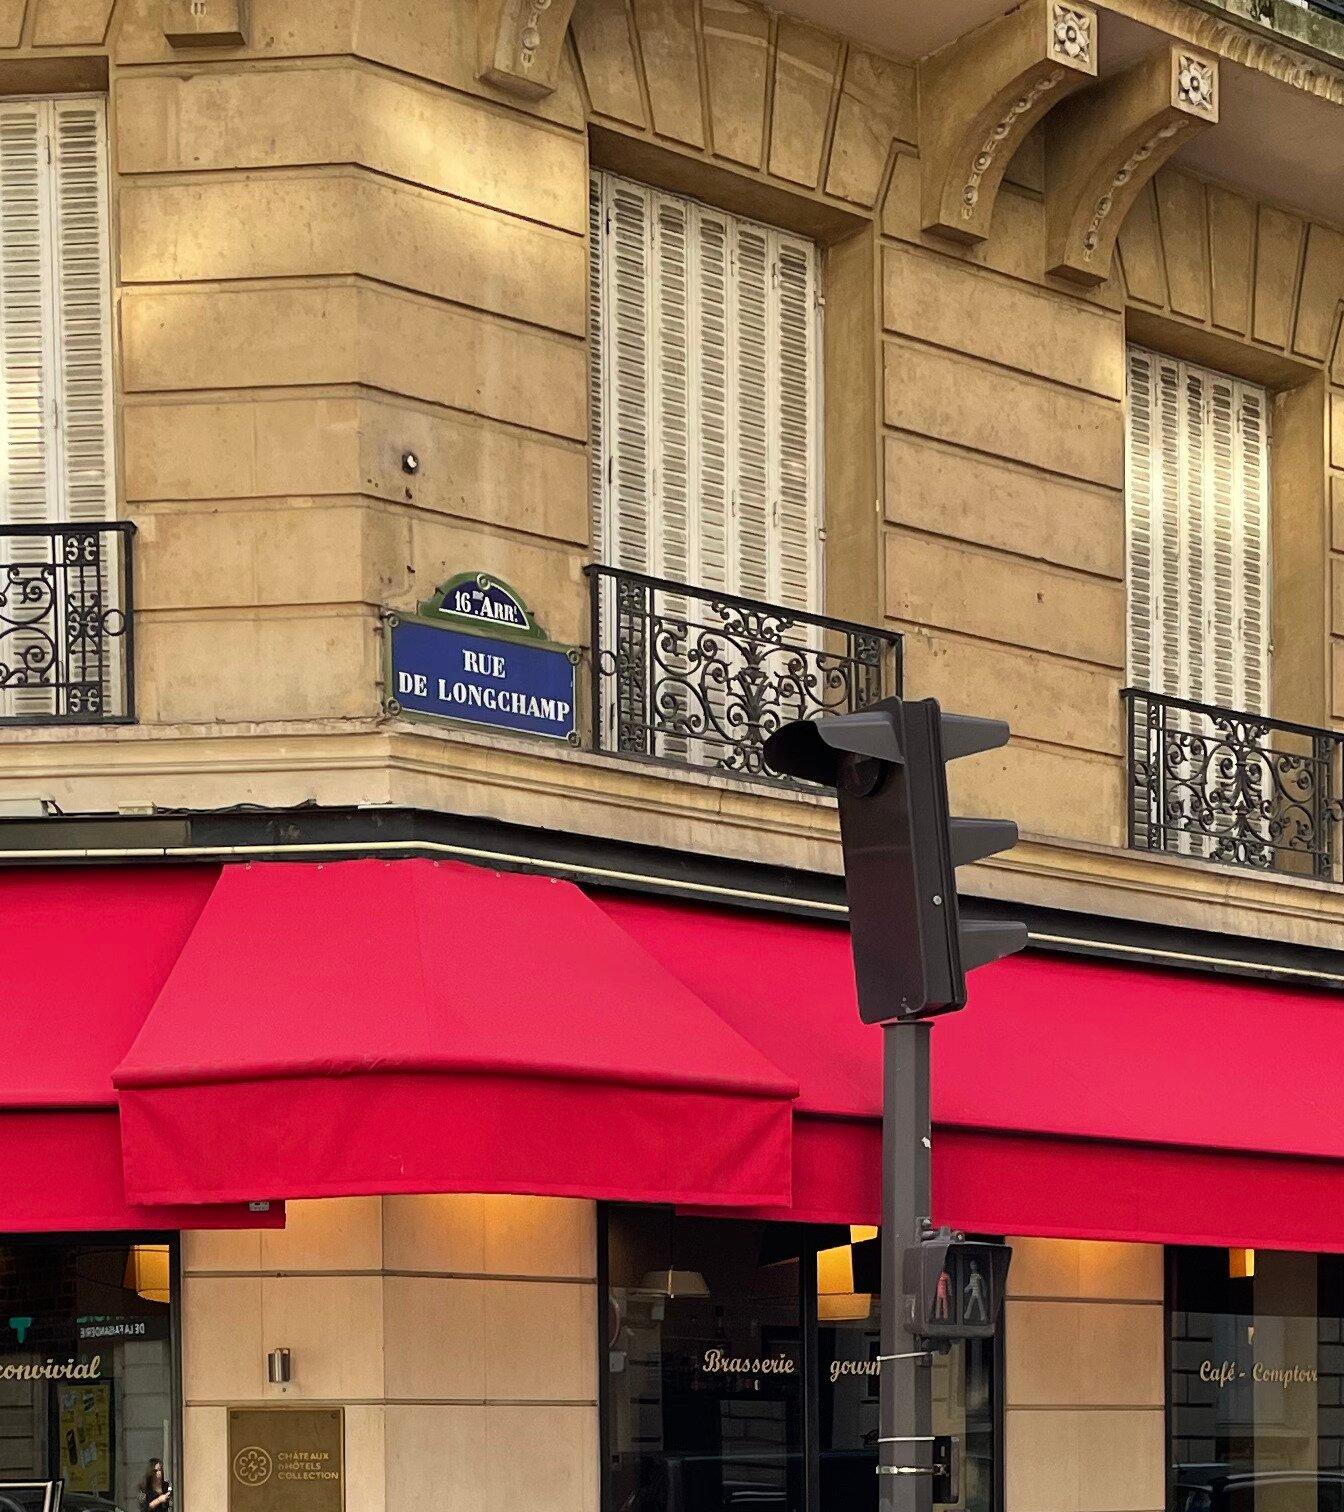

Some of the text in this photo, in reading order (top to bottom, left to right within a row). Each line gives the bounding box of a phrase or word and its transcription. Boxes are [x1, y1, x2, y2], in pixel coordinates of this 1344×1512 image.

[462, 649, 506, 679] RUE
[398, 671, 571, 722] DE LONGCHAMP
[702, 1348, 795, 1374] Brasserie
[1199, 1360, 1236, 1388] Café
[1252, 1361, 1318, 1389] Comptoir
[277, 1471, 340, 1481] COLLECTION
